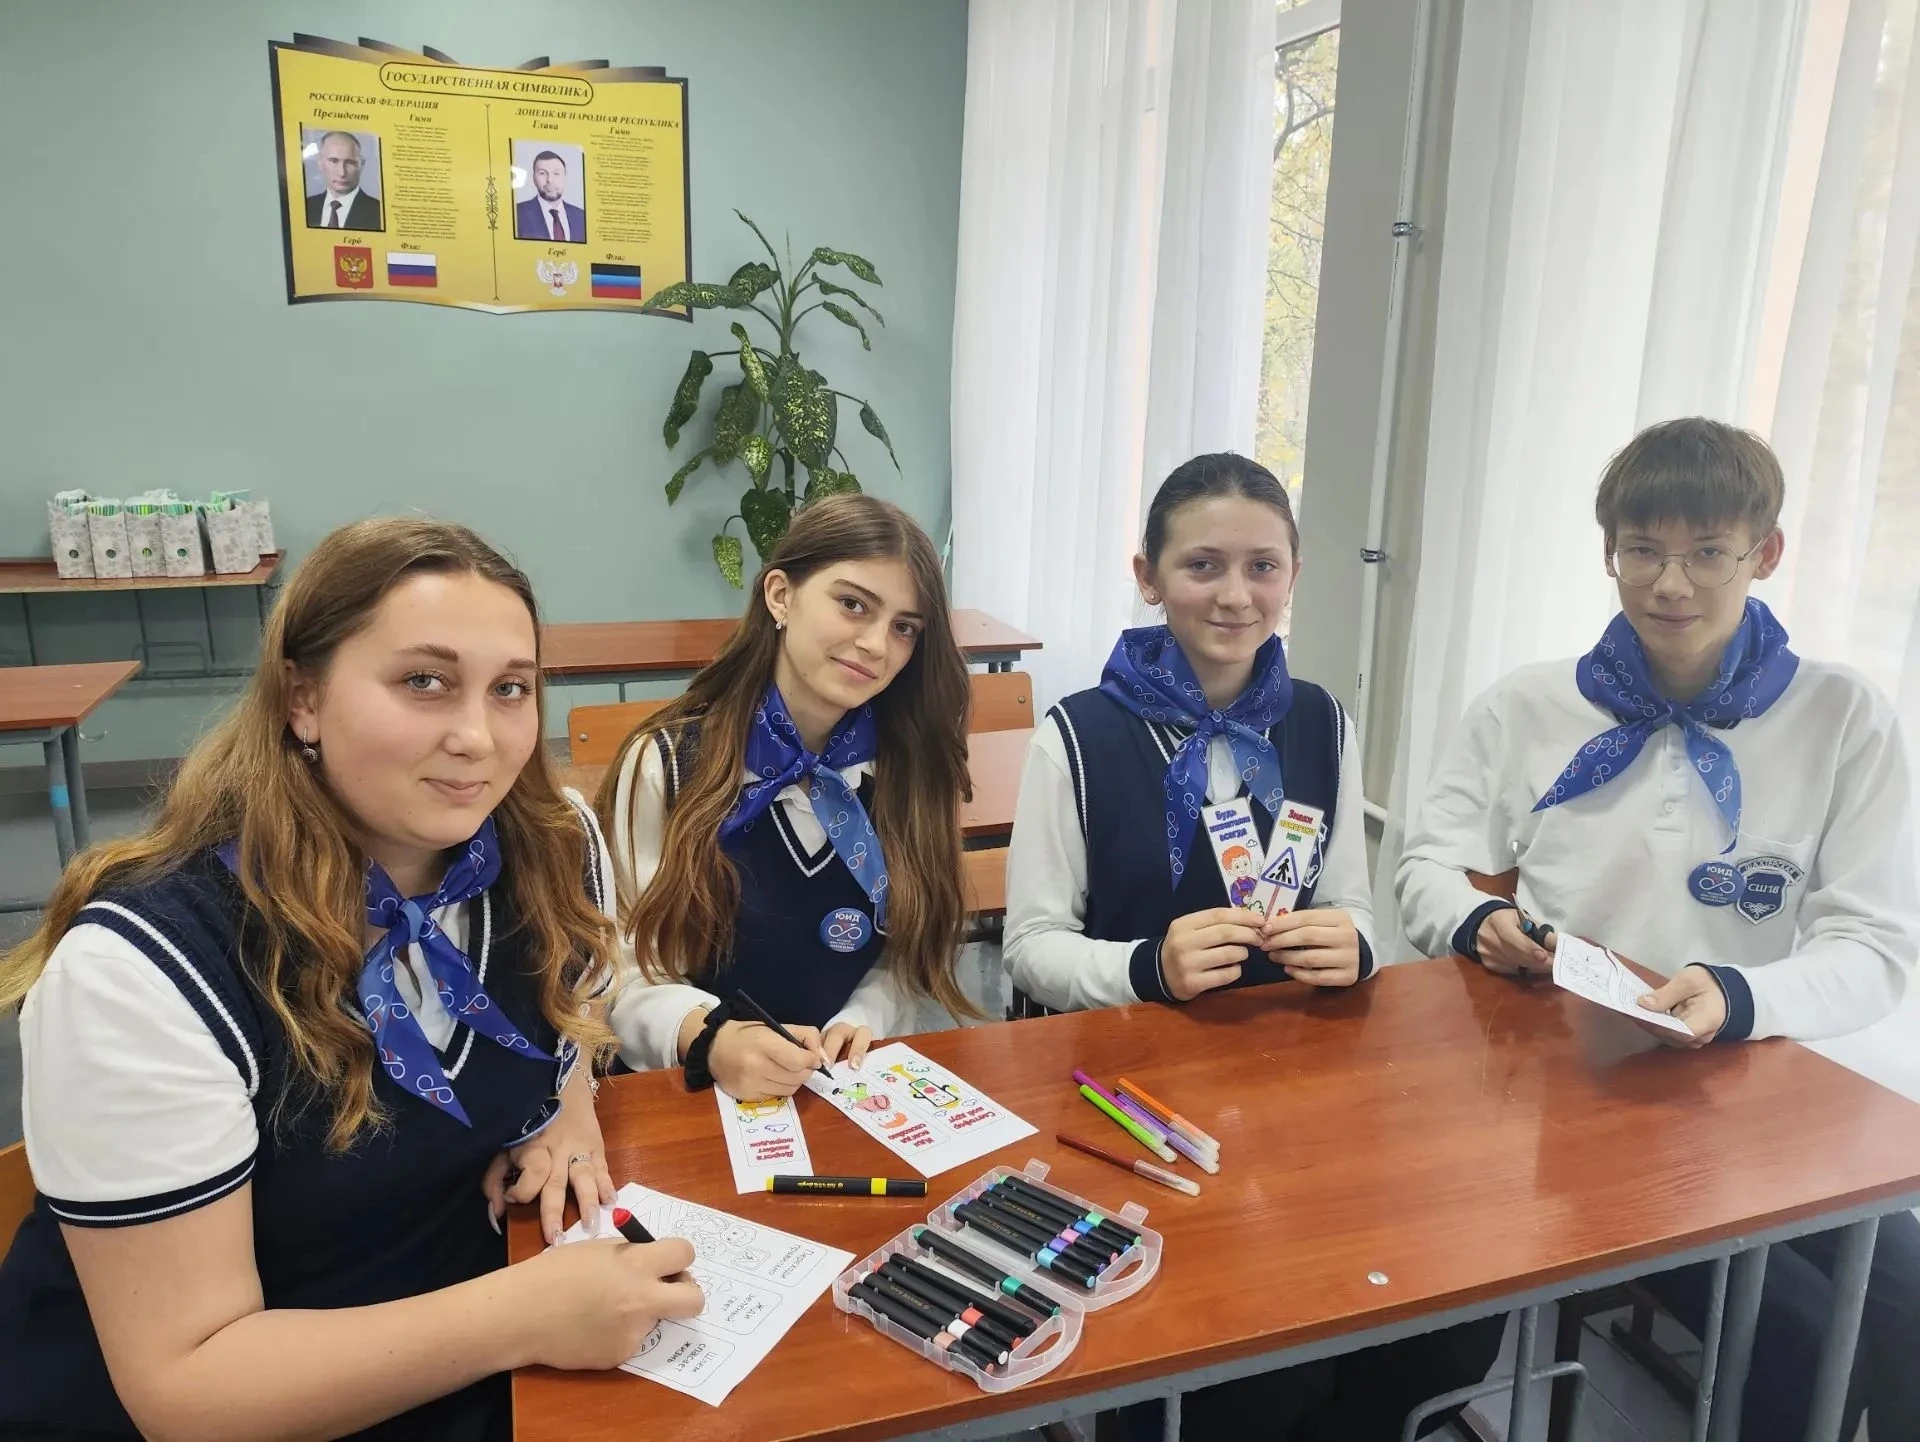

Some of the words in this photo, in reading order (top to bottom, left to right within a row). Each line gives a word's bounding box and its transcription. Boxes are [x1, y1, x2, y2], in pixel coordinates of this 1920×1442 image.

[386, 71, 509, 90] ГОСУДАРСТВЕННАЯ
[513, 83, 588, 98] СИМВОЛИКА
[308, 92, 376, 105] РОССИЙСКАЯ
[378, 94, 439, 109] ФЕДЕРАЦИЯ
[313, 108, 370, 121] Президент
[515, 108, 567, 119] ДОНЕЦКАЯ
[567, 111, 617, 124] НАРОДНАЯ
[619, 116, 679, 129] РЕСПУБЛИКА
[532, 121, 559, 130] Глава
[609, 127, 631, 136] Гимн
[548, 247, 567, 256] Герб
[1706, 865, 1733, 877] ЮИД
[835, 912, 860, 923] ЮИД
[780, 1249, 815, 1279] Переходи
[744, 1302, 766, 1320] Жди
[667, 1341, 692, 1363] жизнь
[674, 1343, 706, 1373] спасает
[691, 1351, 718, 1372] Шлем
